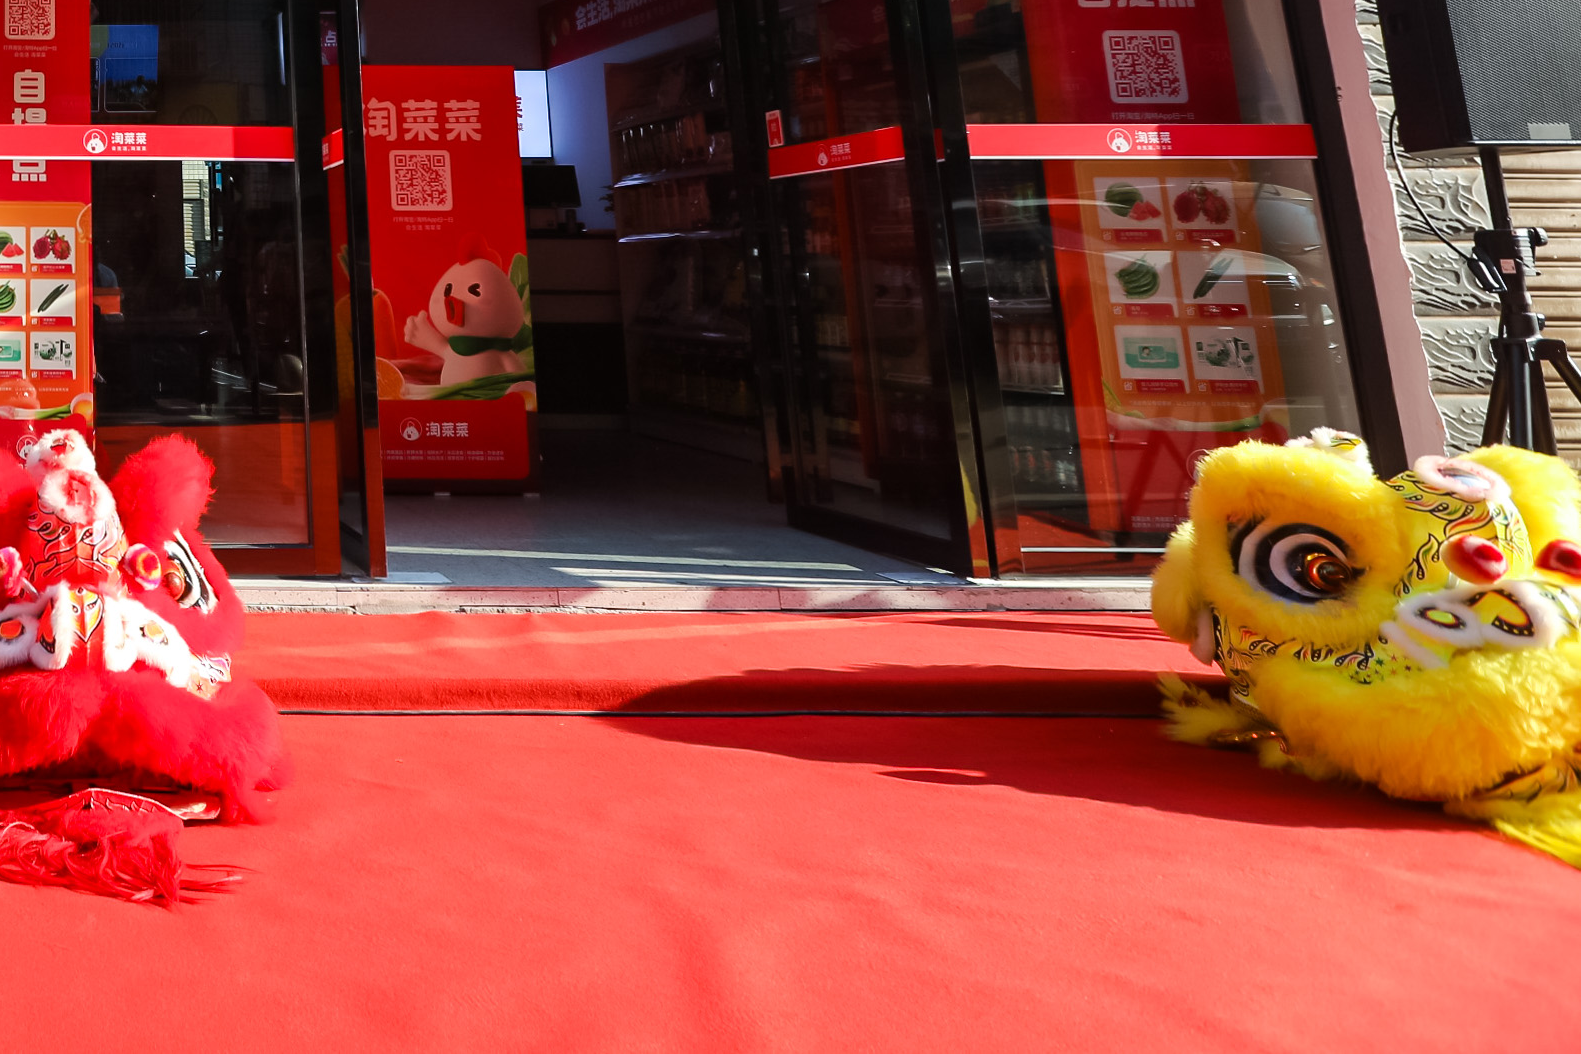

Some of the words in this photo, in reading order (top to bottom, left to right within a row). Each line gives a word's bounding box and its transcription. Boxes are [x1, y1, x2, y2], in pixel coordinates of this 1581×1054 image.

[363, 97, 482, 142] 淘菜菜
[111, 132, 147, 145] 淘菜菜
[1134, 130, 1172, 145] 淘菜菜
[425, 421, 469, 438] 淘菜菜
